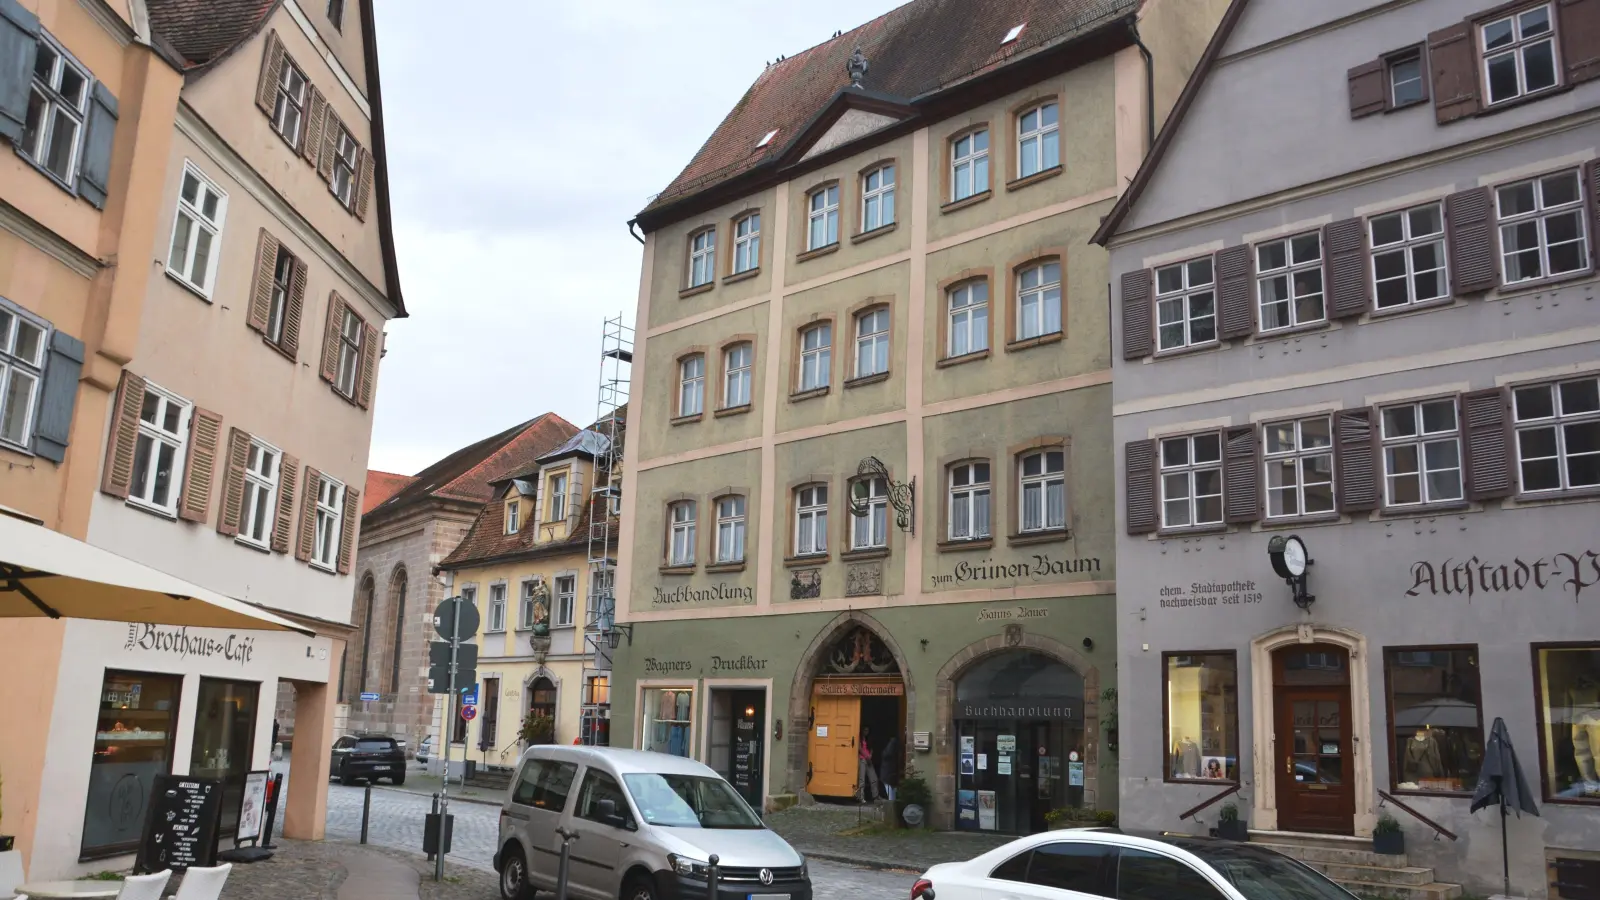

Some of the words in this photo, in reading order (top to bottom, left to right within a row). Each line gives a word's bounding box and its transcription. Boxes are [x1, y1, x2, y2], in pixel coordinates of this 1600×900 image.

[931, 573, 953, 588] zum
[954, 558, 1030, 587] Grünen
[1030, 554, 1101, 582] Baum
[652, 582, 753, 607] Buchhandlung
[1190, 580, 1256, 595] Stadtapotheke
[1160, 596, 1218, 609] nachweisbar
[1222, 593, 1240, 605] seit
[1243, 592, 1263, 604] 1519
[644, 656, 692, 675] Wagners
[711, 655, 768, 675] Druckbar
[965, 705, 1072, 719] Buchhandlung
